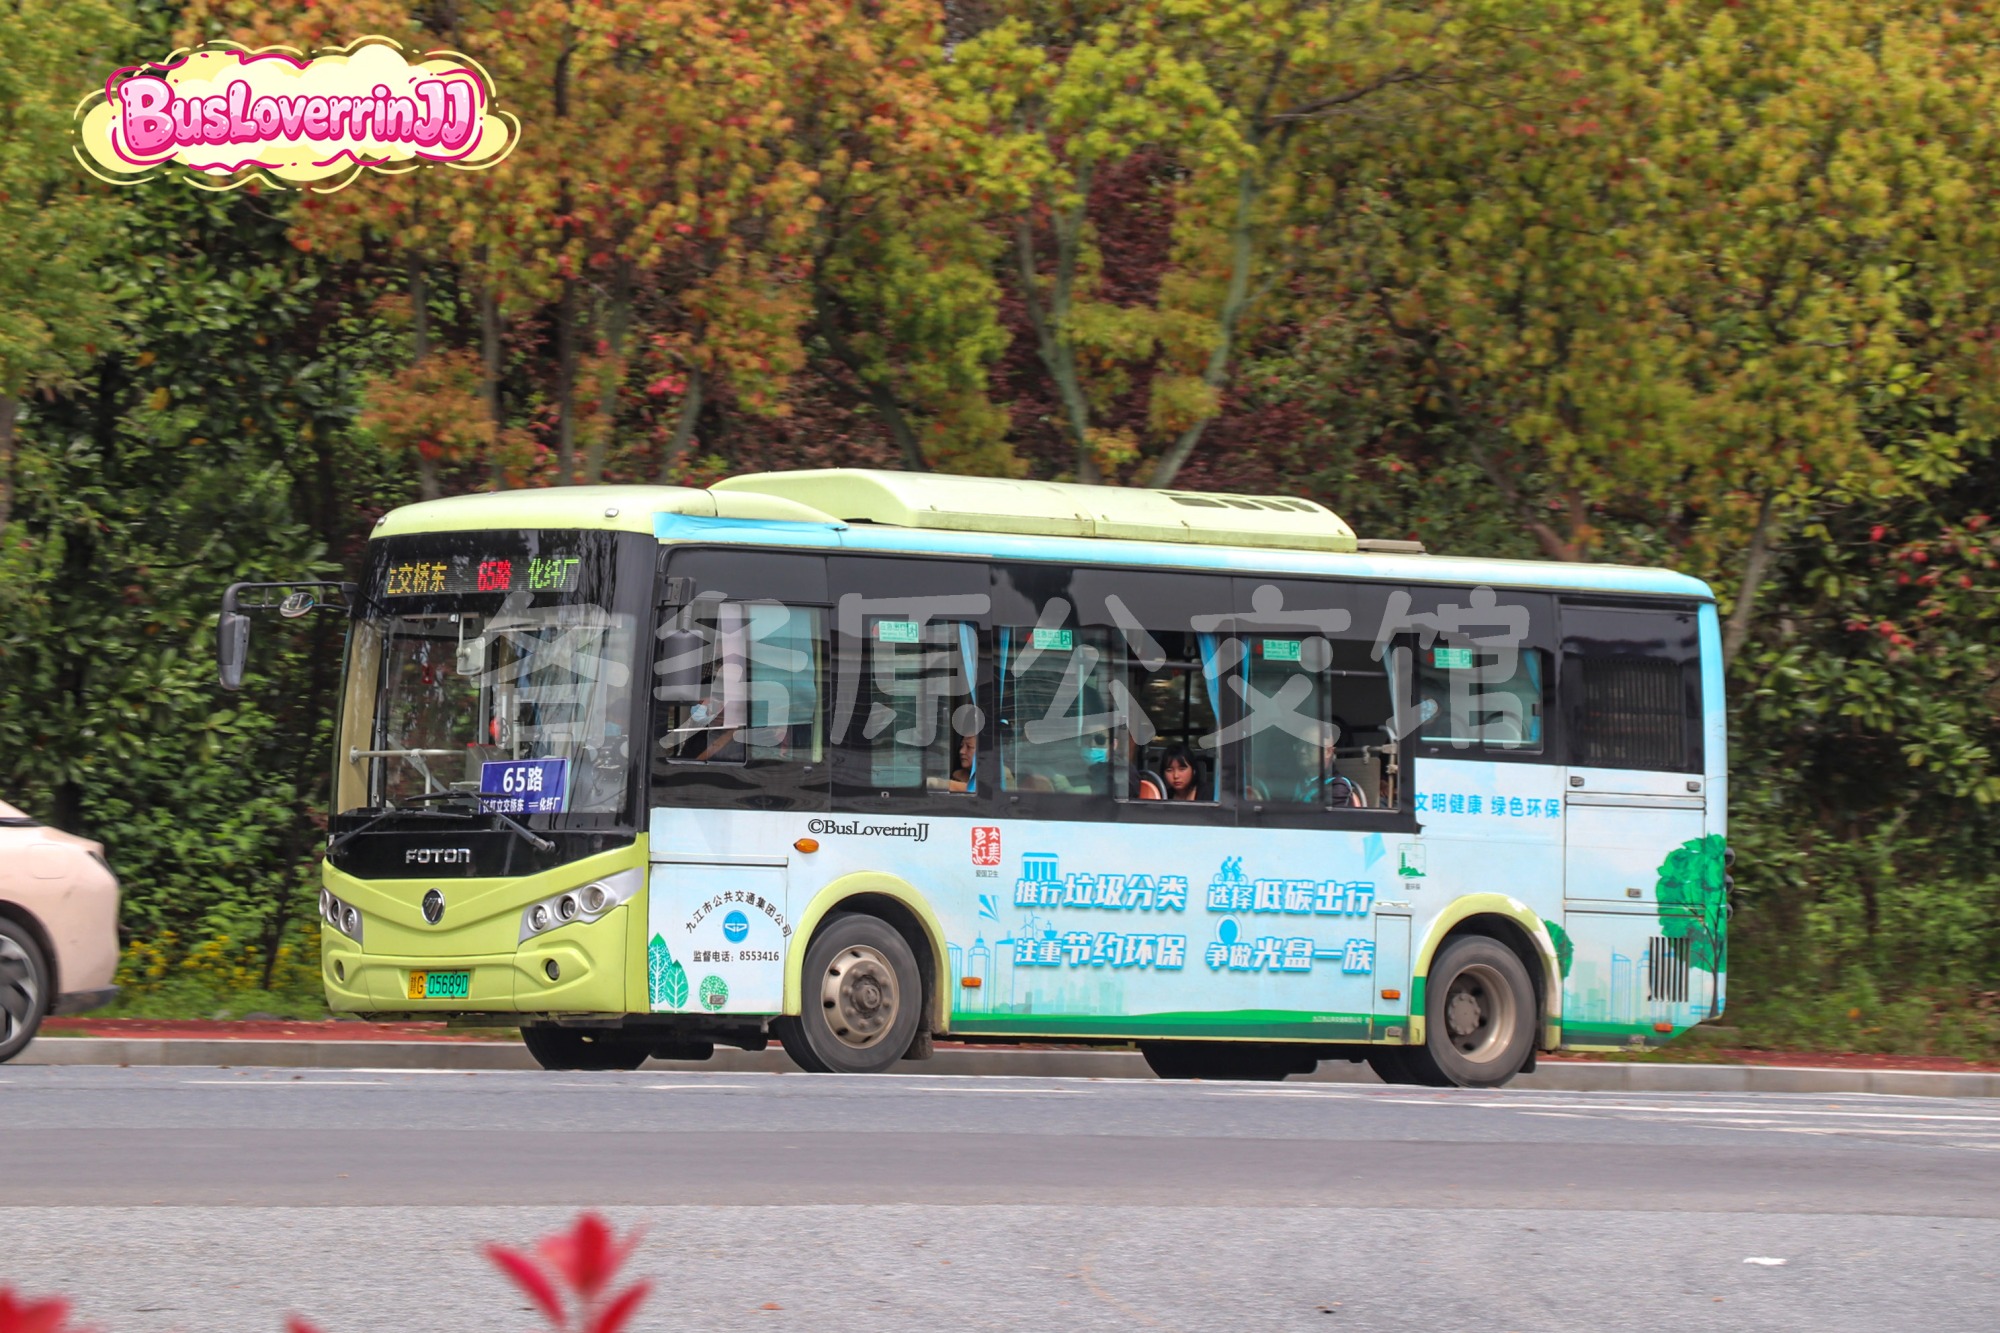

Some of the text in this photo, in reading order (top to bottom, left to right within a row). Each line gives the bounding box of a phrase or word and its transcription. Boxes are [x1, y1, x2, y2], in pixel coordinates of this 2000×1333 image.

[477, 560, 512, 591] 65路
[528, 558, 579, 589] 化纤厂
[503, 766, 543, 792] 65路
[540, 797, 560, 811] 化纤厂
[1414, 792, 1560, 818] 文明健康 绿色环保
[405, 848, 470, 864] FOTON
[1014, 873, 1187, 911] 推行垃圾分类
[1206, 879, 1374, 917] 选择低碳出行
[686, 890, 792, 937] 九江市公共交通集团公司
[1014, 932, 1187, 970] 注重节约环保
[1205, 936, 1375, 974] 争做光盘一族
